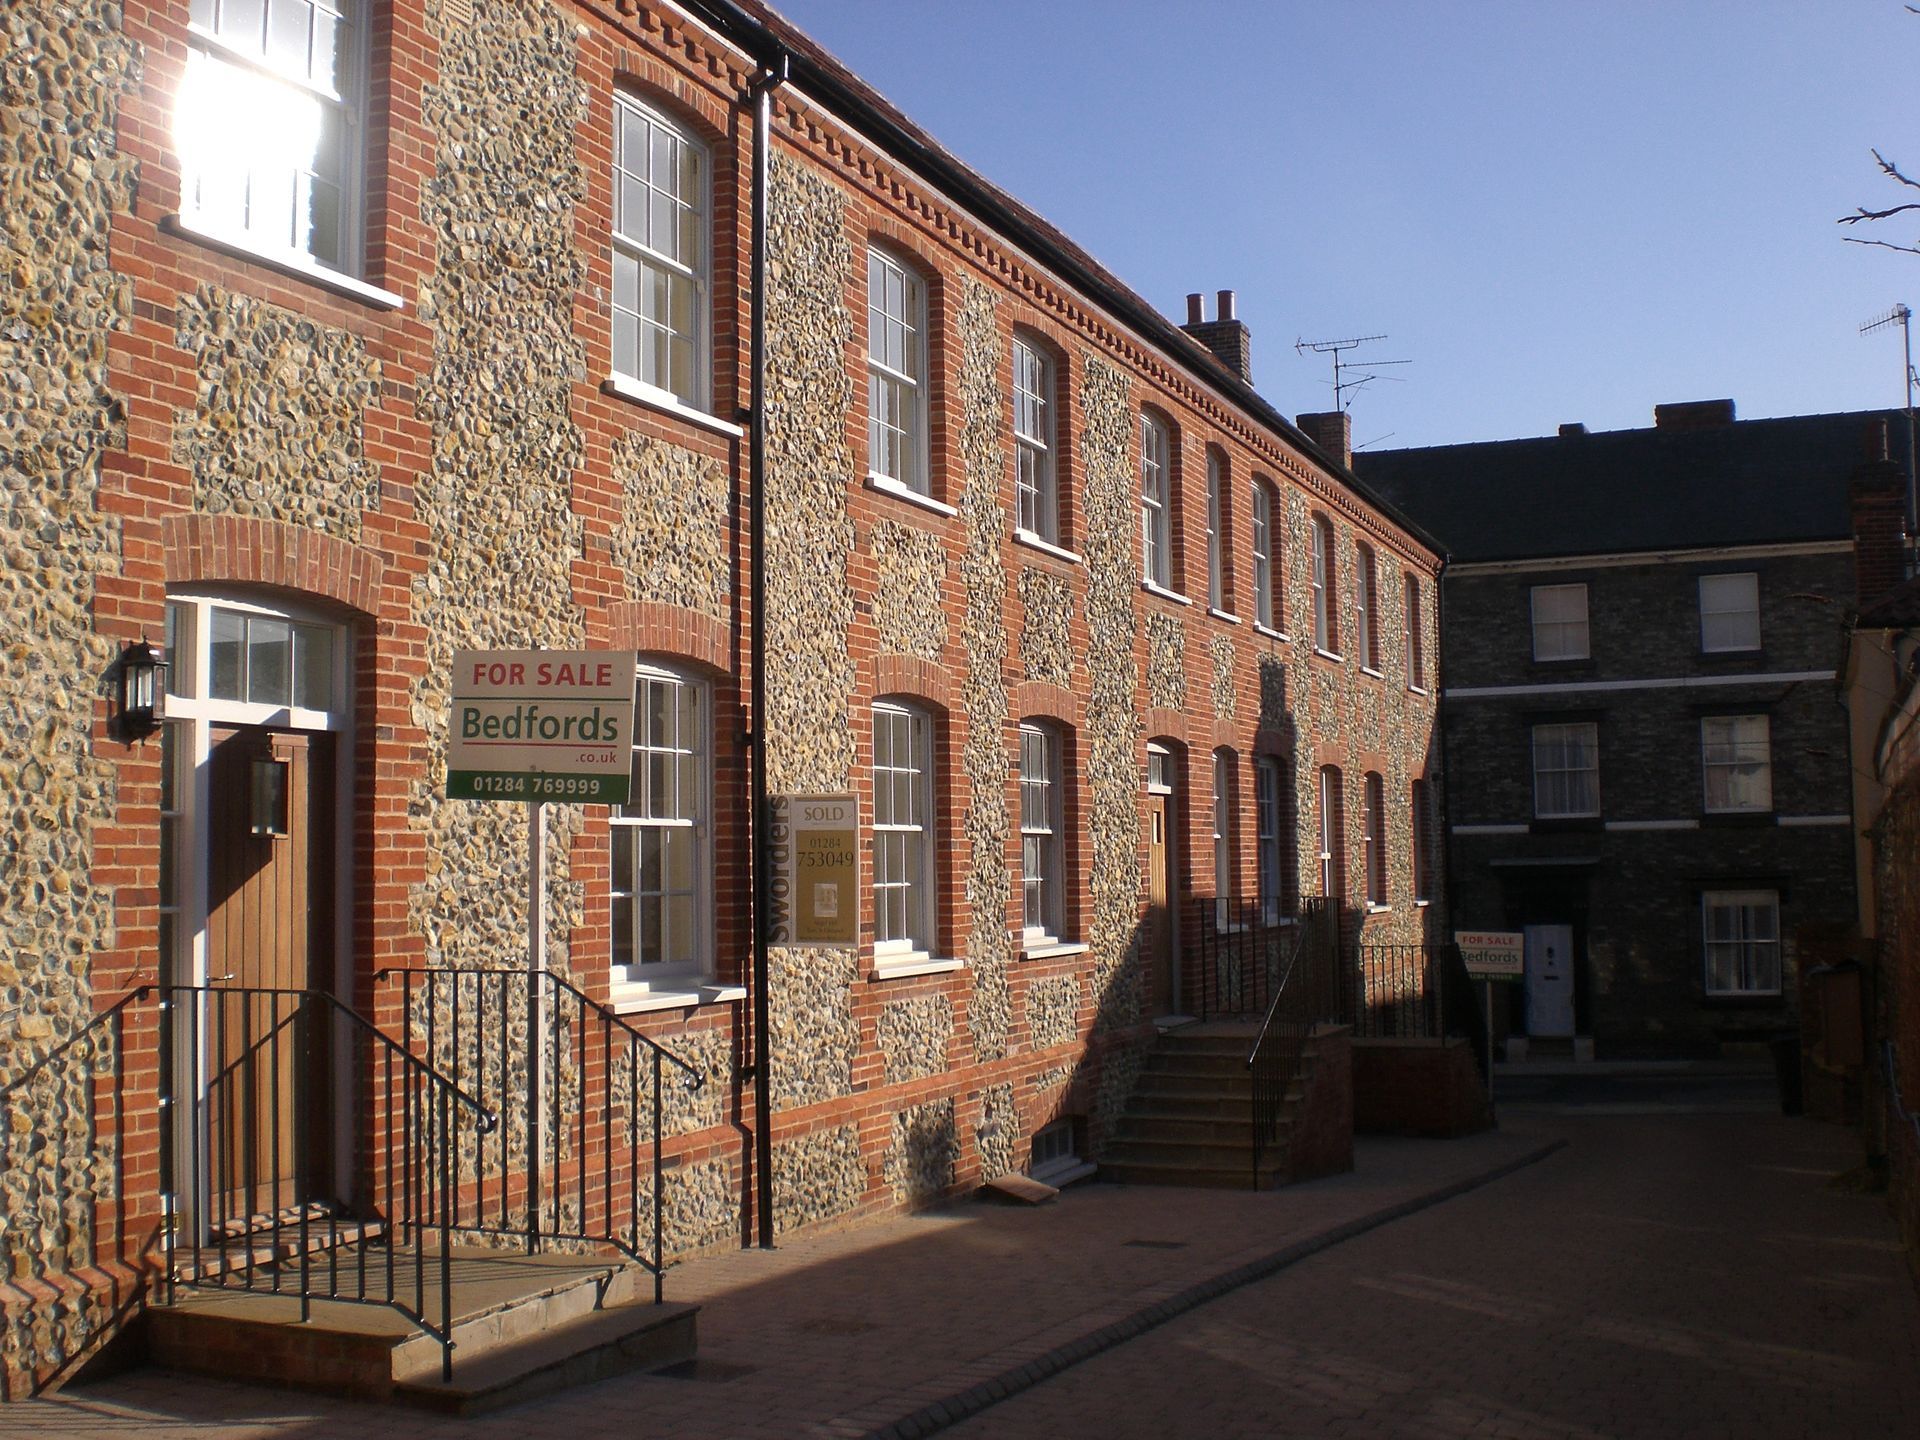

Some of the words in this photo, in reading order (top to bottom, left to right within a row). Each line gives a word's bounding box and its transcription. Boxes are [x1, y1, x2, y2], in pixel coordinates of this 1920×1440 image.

[473, 663, 525, 686] FOR
[537, 663, 612, 687] SALE
[462, 705, 618, 741] Bedfords
[575, 752, 617, 763] .co.uk
[473, 776, 525, 792] 01284
[532, 778, 600, 794] 769999
[804, 806, 844, 821] SOLD
[809, 838, 841, 849] 01284
[797, 851, 854, 867] 753049
[768, 795, 790, 944] Sworders
[1462, 935, 1483, 944] FOR
[1487, 936, 1515, 945] SALE
